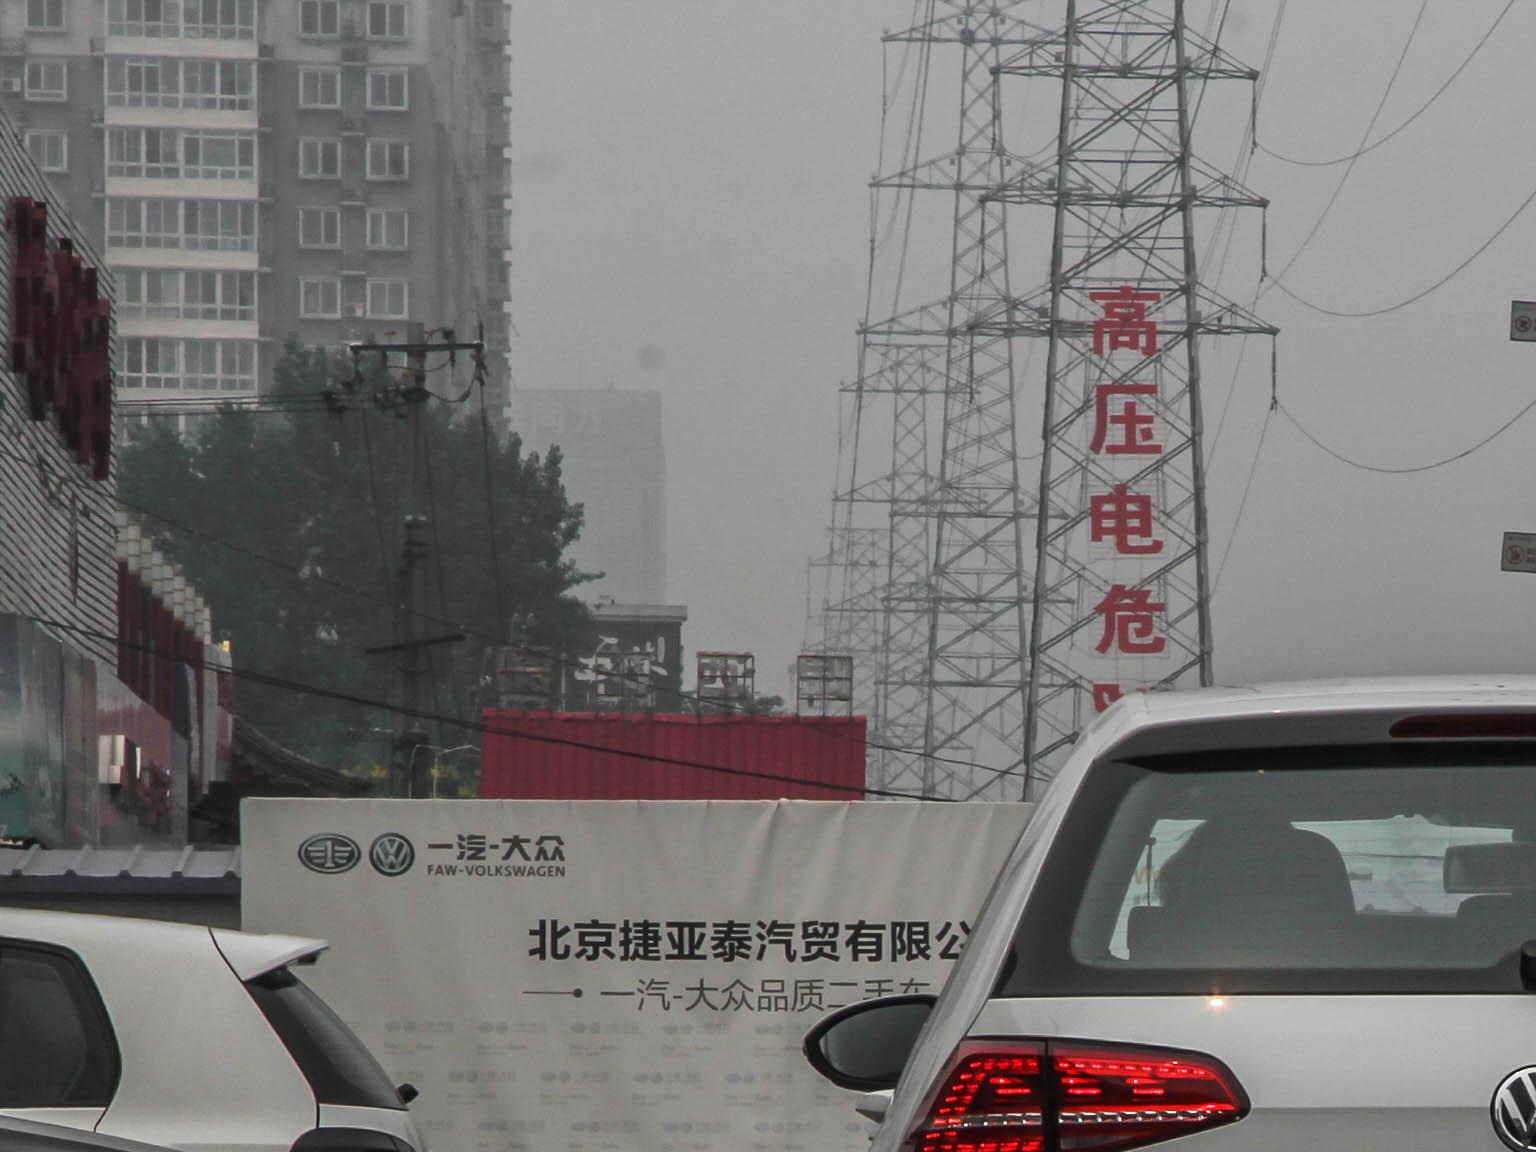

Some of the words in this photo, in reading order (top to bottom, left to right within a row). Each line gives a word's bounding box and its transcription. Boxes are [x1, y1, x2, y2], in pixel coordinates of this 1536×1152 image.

[428, 834, 566, 862] 一汽-大众
[428, 865, 566, 877] FAW-VOLKSWAGEN
[528, 918, 972, 963] 北京捷亚泰汽贸有限公
